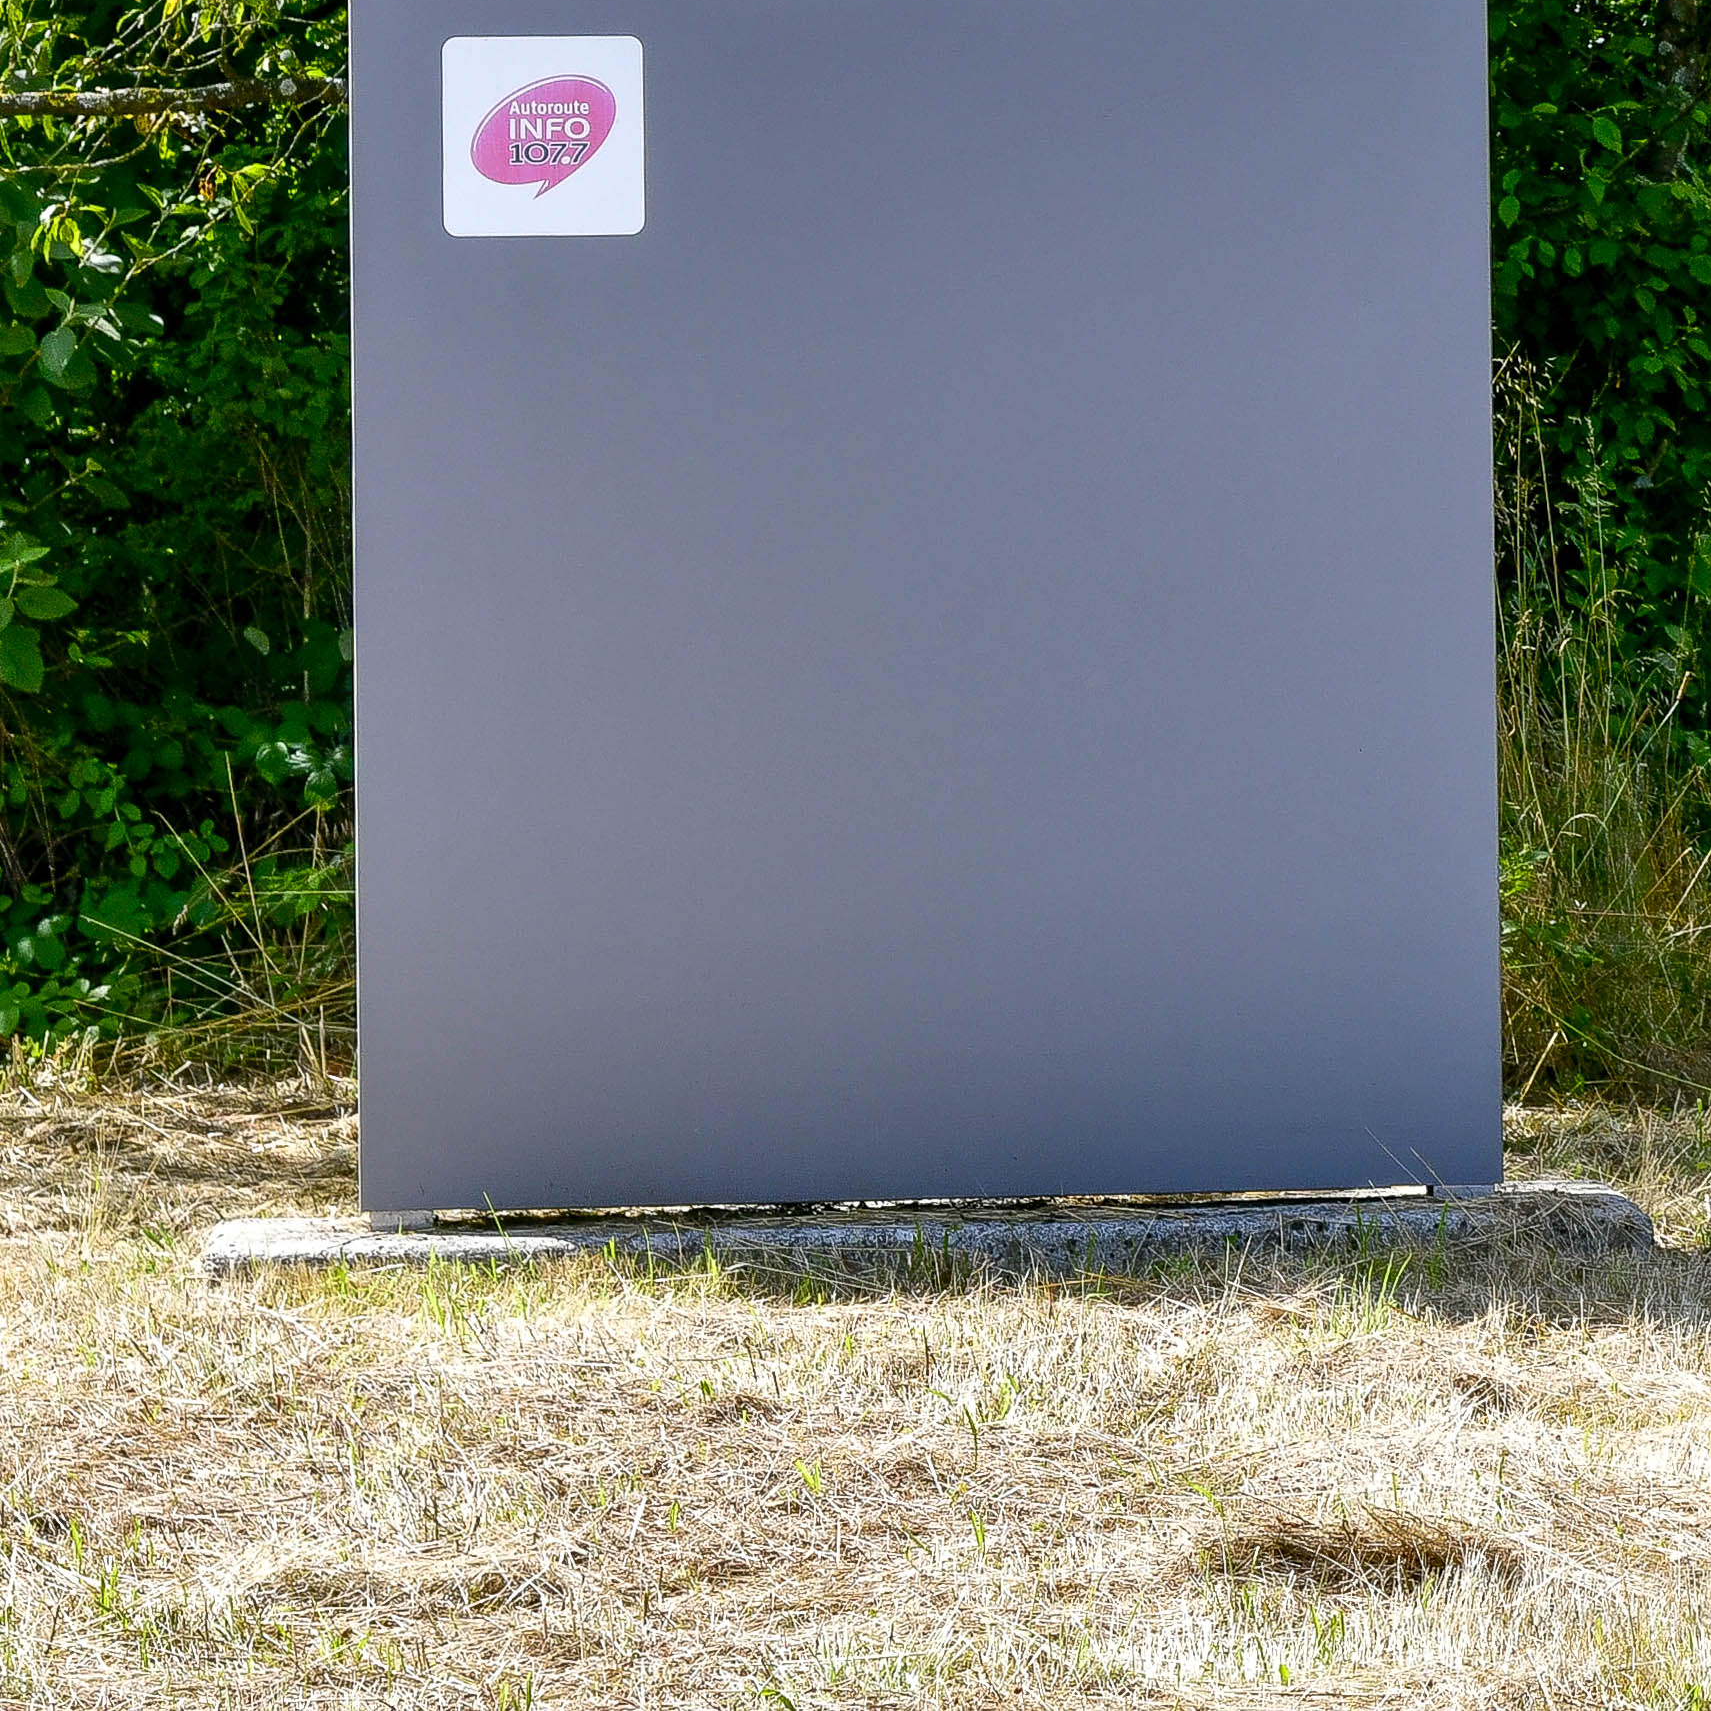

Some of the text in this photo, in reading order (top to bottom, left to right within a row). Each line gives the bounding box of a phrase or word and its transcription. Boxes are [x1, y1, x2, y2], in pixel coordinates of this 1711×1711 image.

[510, 101, 589, 114] Autoroute
[509, 118, 590, 139] INFO
[509, 142, 589, 165] 107.7
